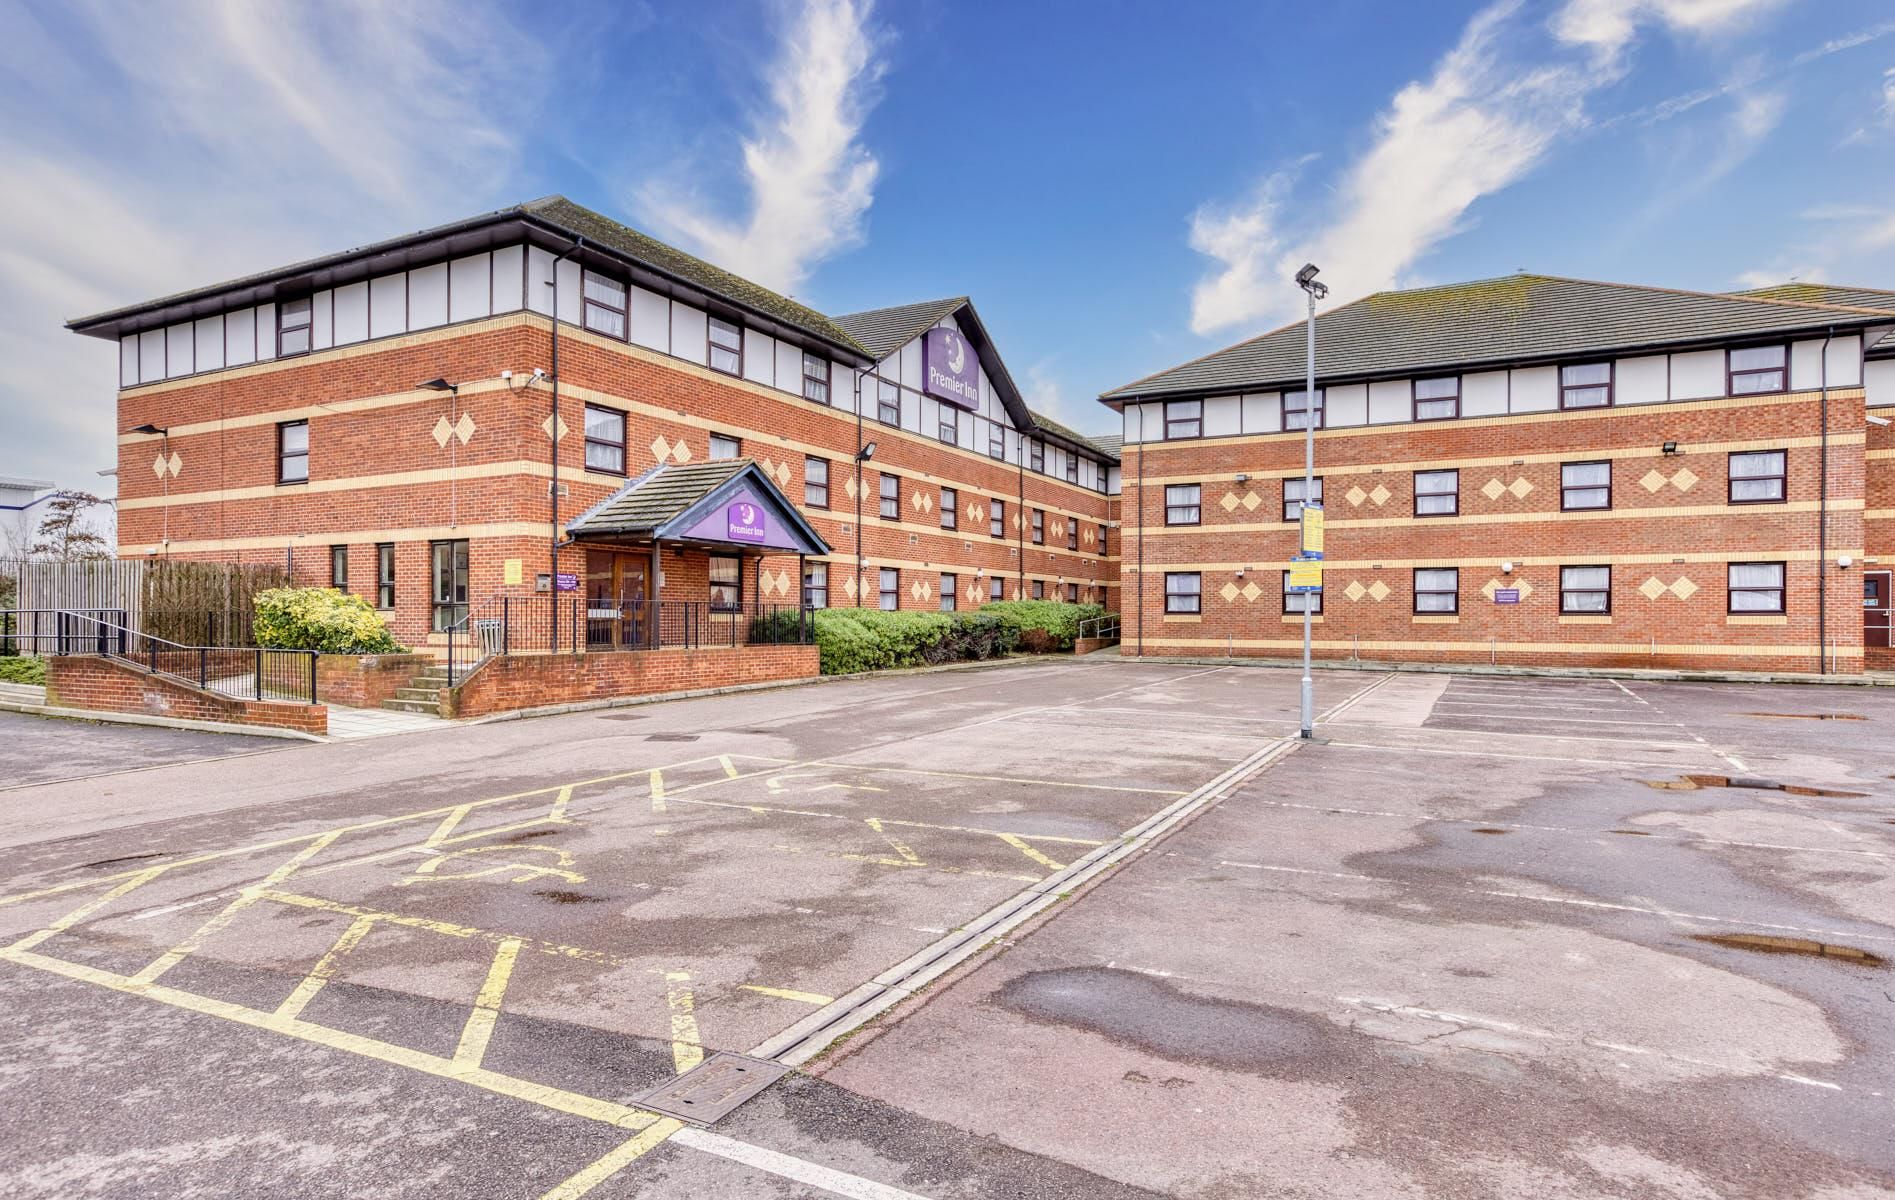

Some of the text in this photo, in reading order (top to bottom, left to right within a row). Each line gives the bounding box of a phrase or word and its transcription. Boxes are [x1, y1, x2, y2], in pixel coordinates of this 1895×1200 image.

[930, 366, 977, 400] Premier Inn
[730, 523, 764, 536] Premier Inn
